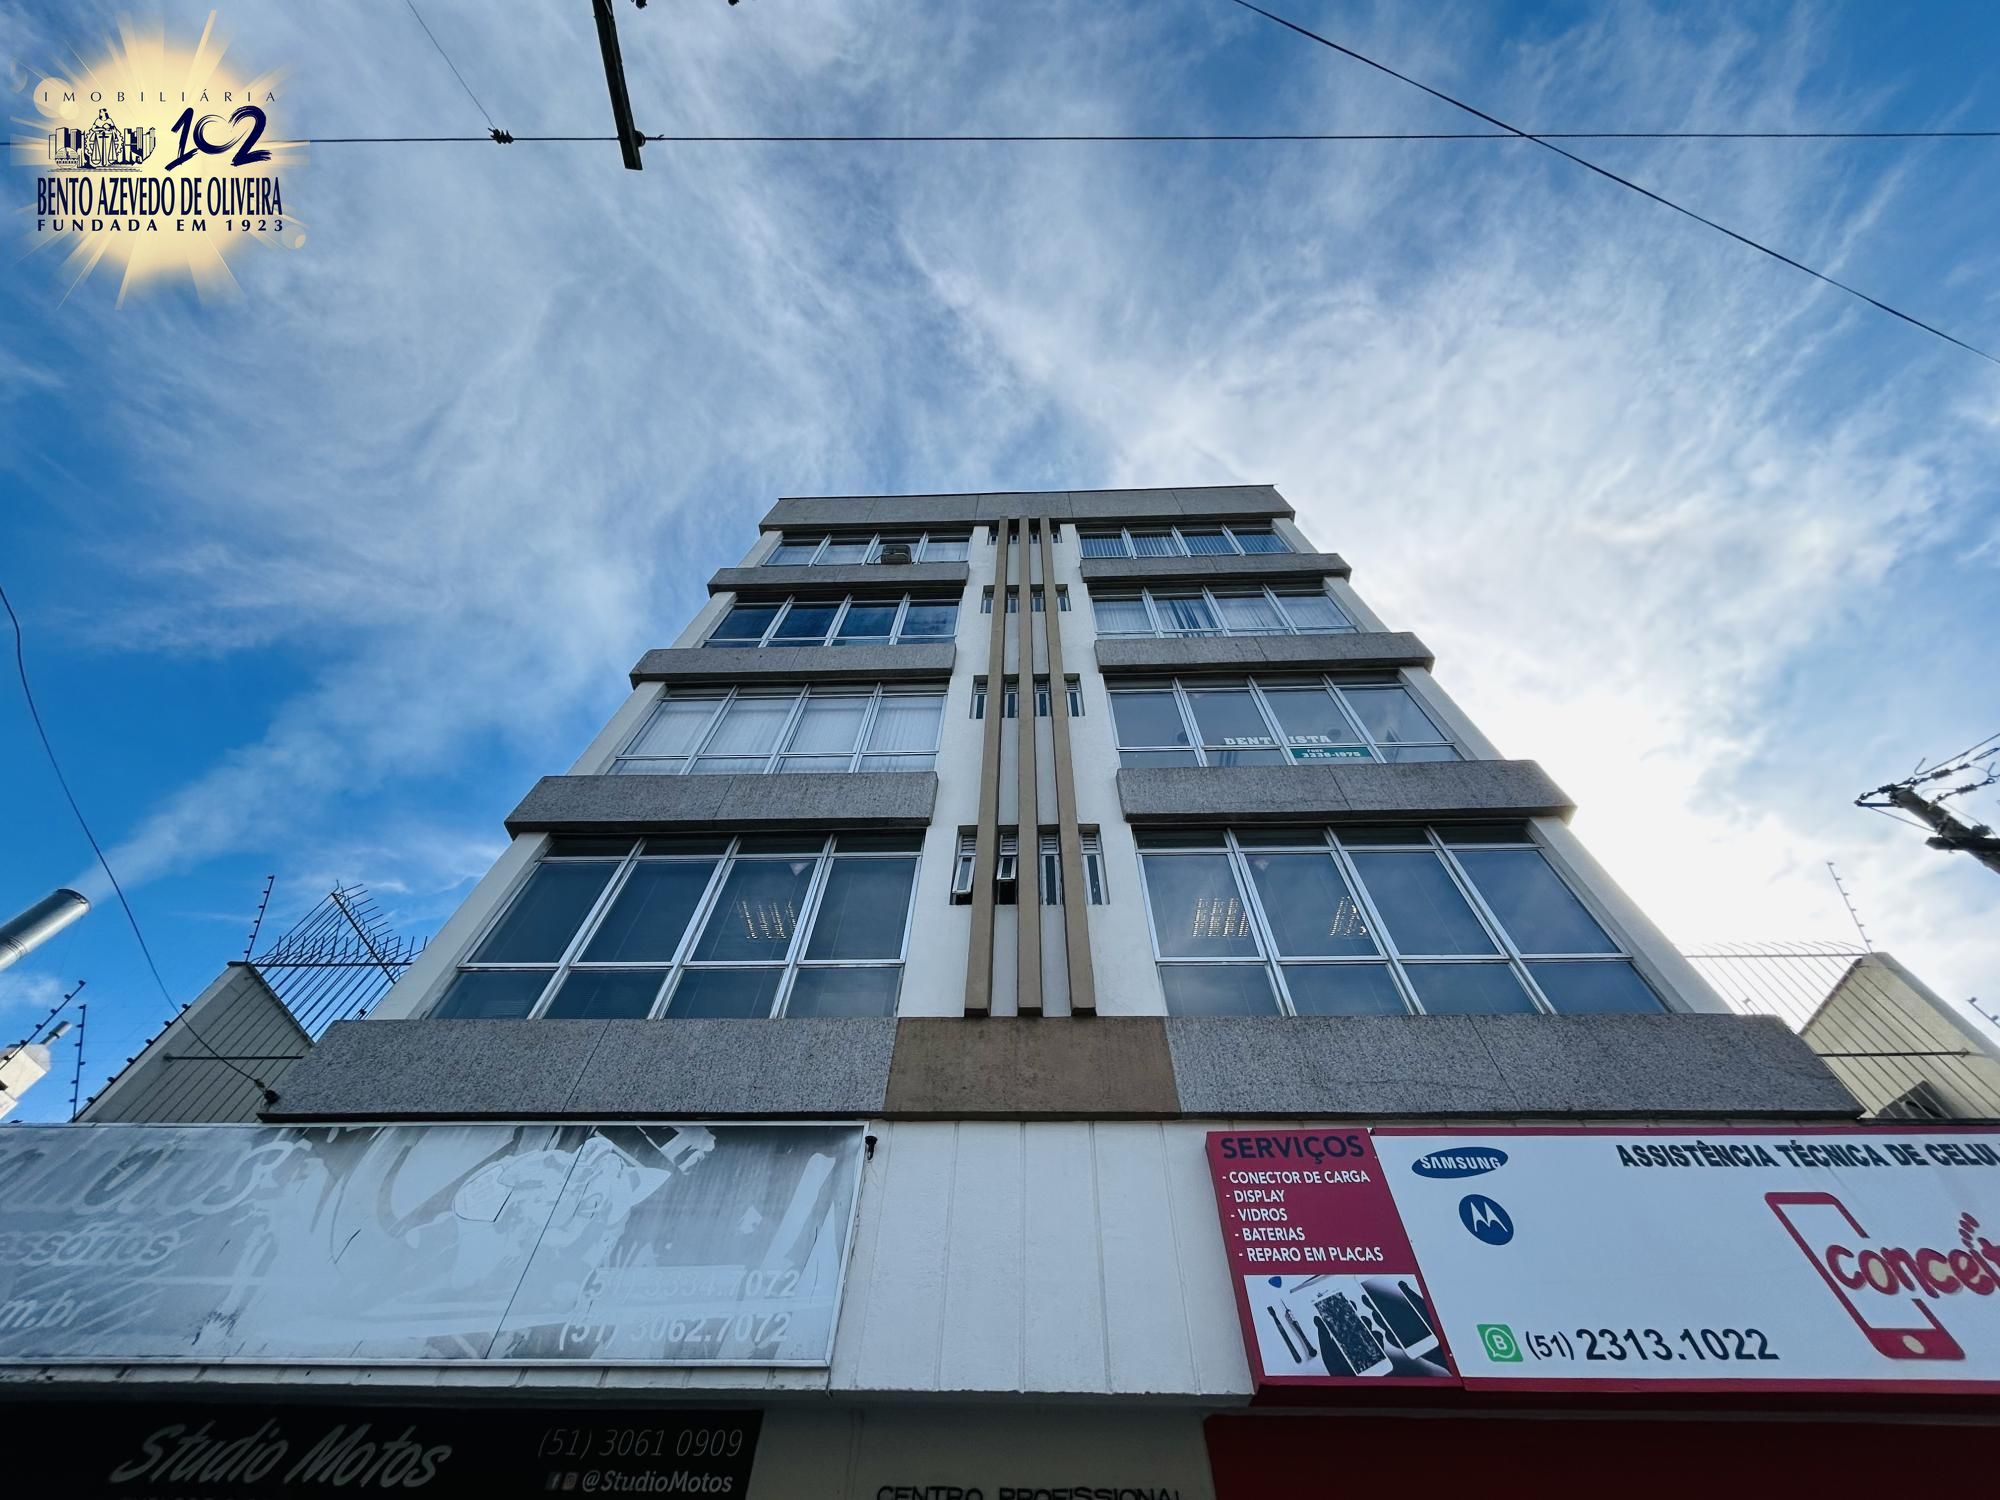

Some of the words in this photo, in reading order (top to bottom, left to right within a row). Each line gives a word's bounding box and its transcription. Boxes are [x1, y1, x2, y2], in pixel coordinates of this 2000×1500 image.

[1220, 1135, 1365, 1164] SERVIÇOS
[1615, 1140, 1780, 1167] ASSISTÊNCIA
[1774, 1139, 1891, 1167] TÉCNICA
[1883, 1143, 1931, 1166] DE
[1924, 1143, 2000, 1166] CELU
[1419, 1156, 1501, 1170] SAMSUNG
[1229, 1171, 1301, 1184] CONECTOR
[1303, 1171, 1322, 1184] DE
[1324, 1170, 1371, 1184] CARGA
[1234, 1189, 1285, 1203] DISPLAY
[1238, 1208, 1288, 1221] VIDROS
[1242, 1227, 1306, 1241] BATERIAS
[1246, 1248, 1301, 1262] REPARO
[1303, 1247, 1327, 1262] EM
[1328, 1247, 1384, 1262] PLACAS
[1525, 1331, 1575, 1361] (51)
[1576, 1328, 1780, 1361] 2313.1022
[537, 1428, 593, 1461] (51)
[599, 1429, 665, 1457] 3061
[675, 1429, 743, 1457] 0909
[109, 1417, 290, 1484] Studio
[283, 1424, 453, 1488] Motos
[582, 1470, 734, 1493] @StudioMotos
[877, 1486, 983, 1500] CENTRO
